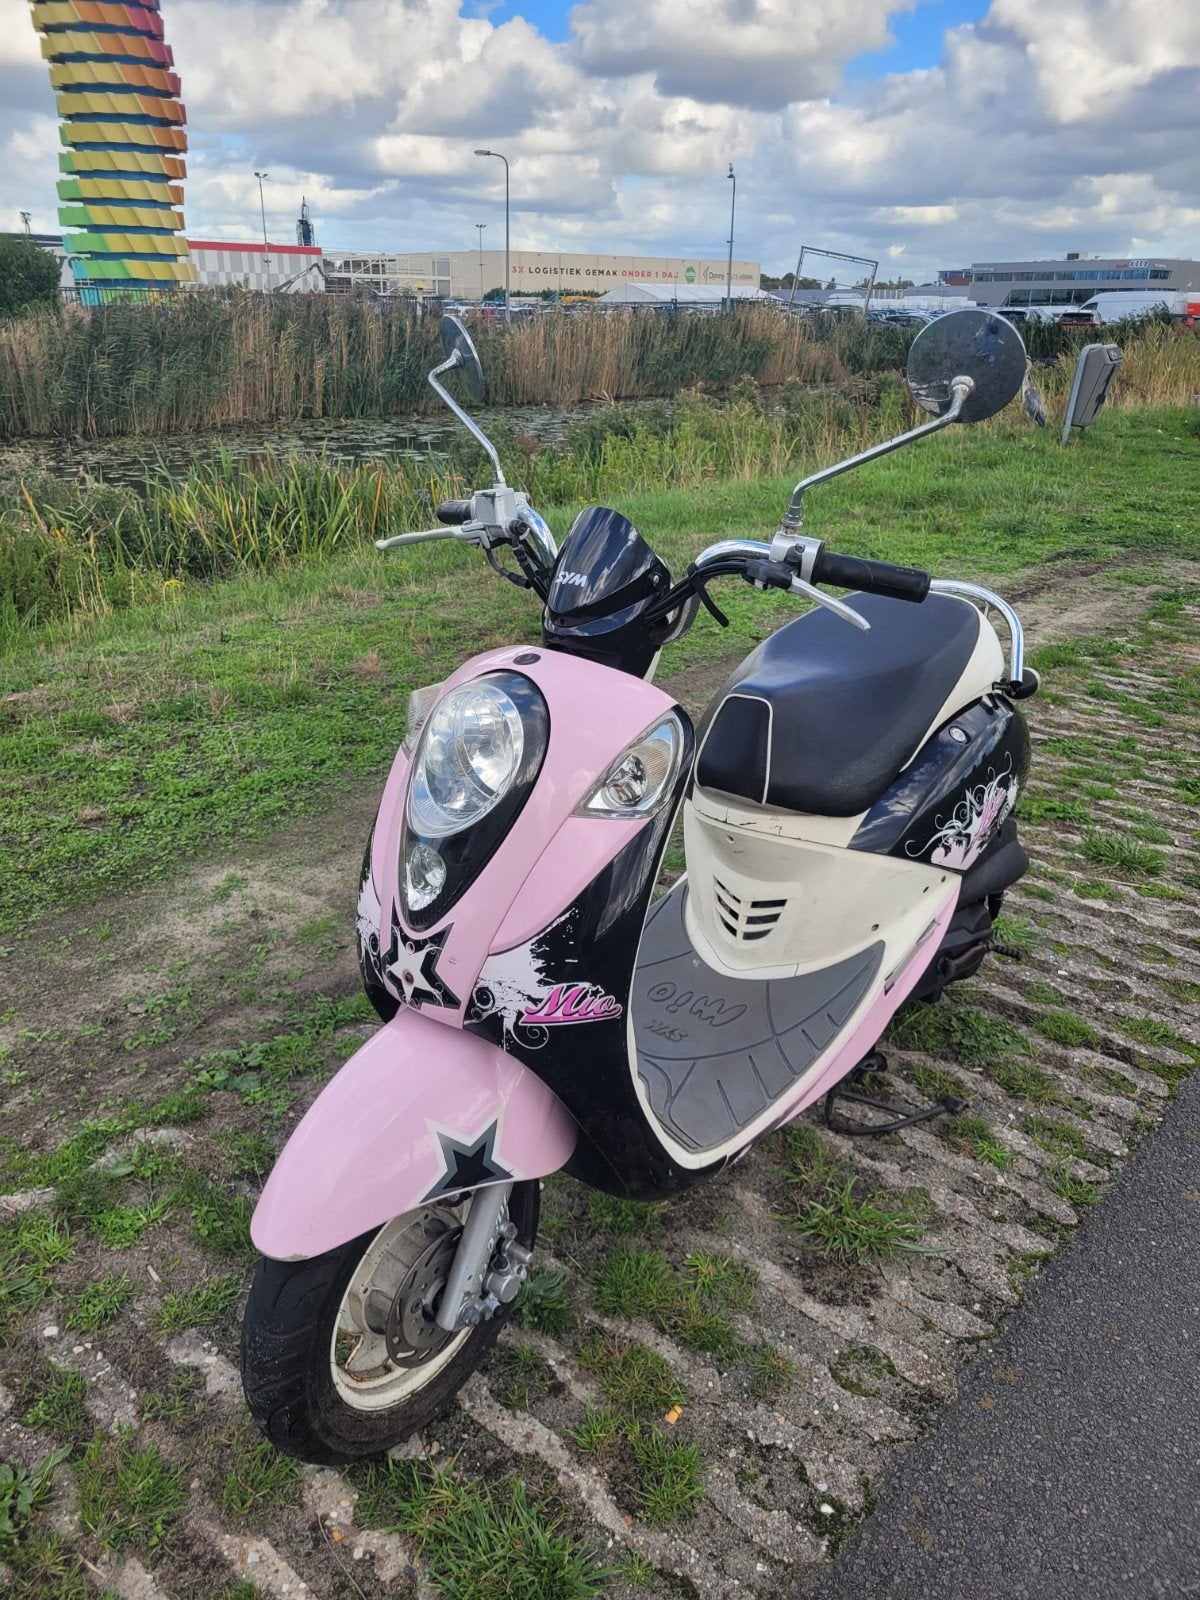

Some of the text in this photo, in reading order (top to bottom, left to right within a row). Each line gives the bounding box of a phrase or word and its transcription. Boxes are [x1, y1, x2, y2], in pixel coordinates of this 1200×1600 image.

[528, 267, 582, 275] LOGISTIEK
[585, 269, 618, 277] GEMAK
[621, 270, 652, 278] ONDER
[555, 570, 588, 588] SYM
[523, 984, 622, 1019] Mio
[647, 981, 749, 1027] Mio
